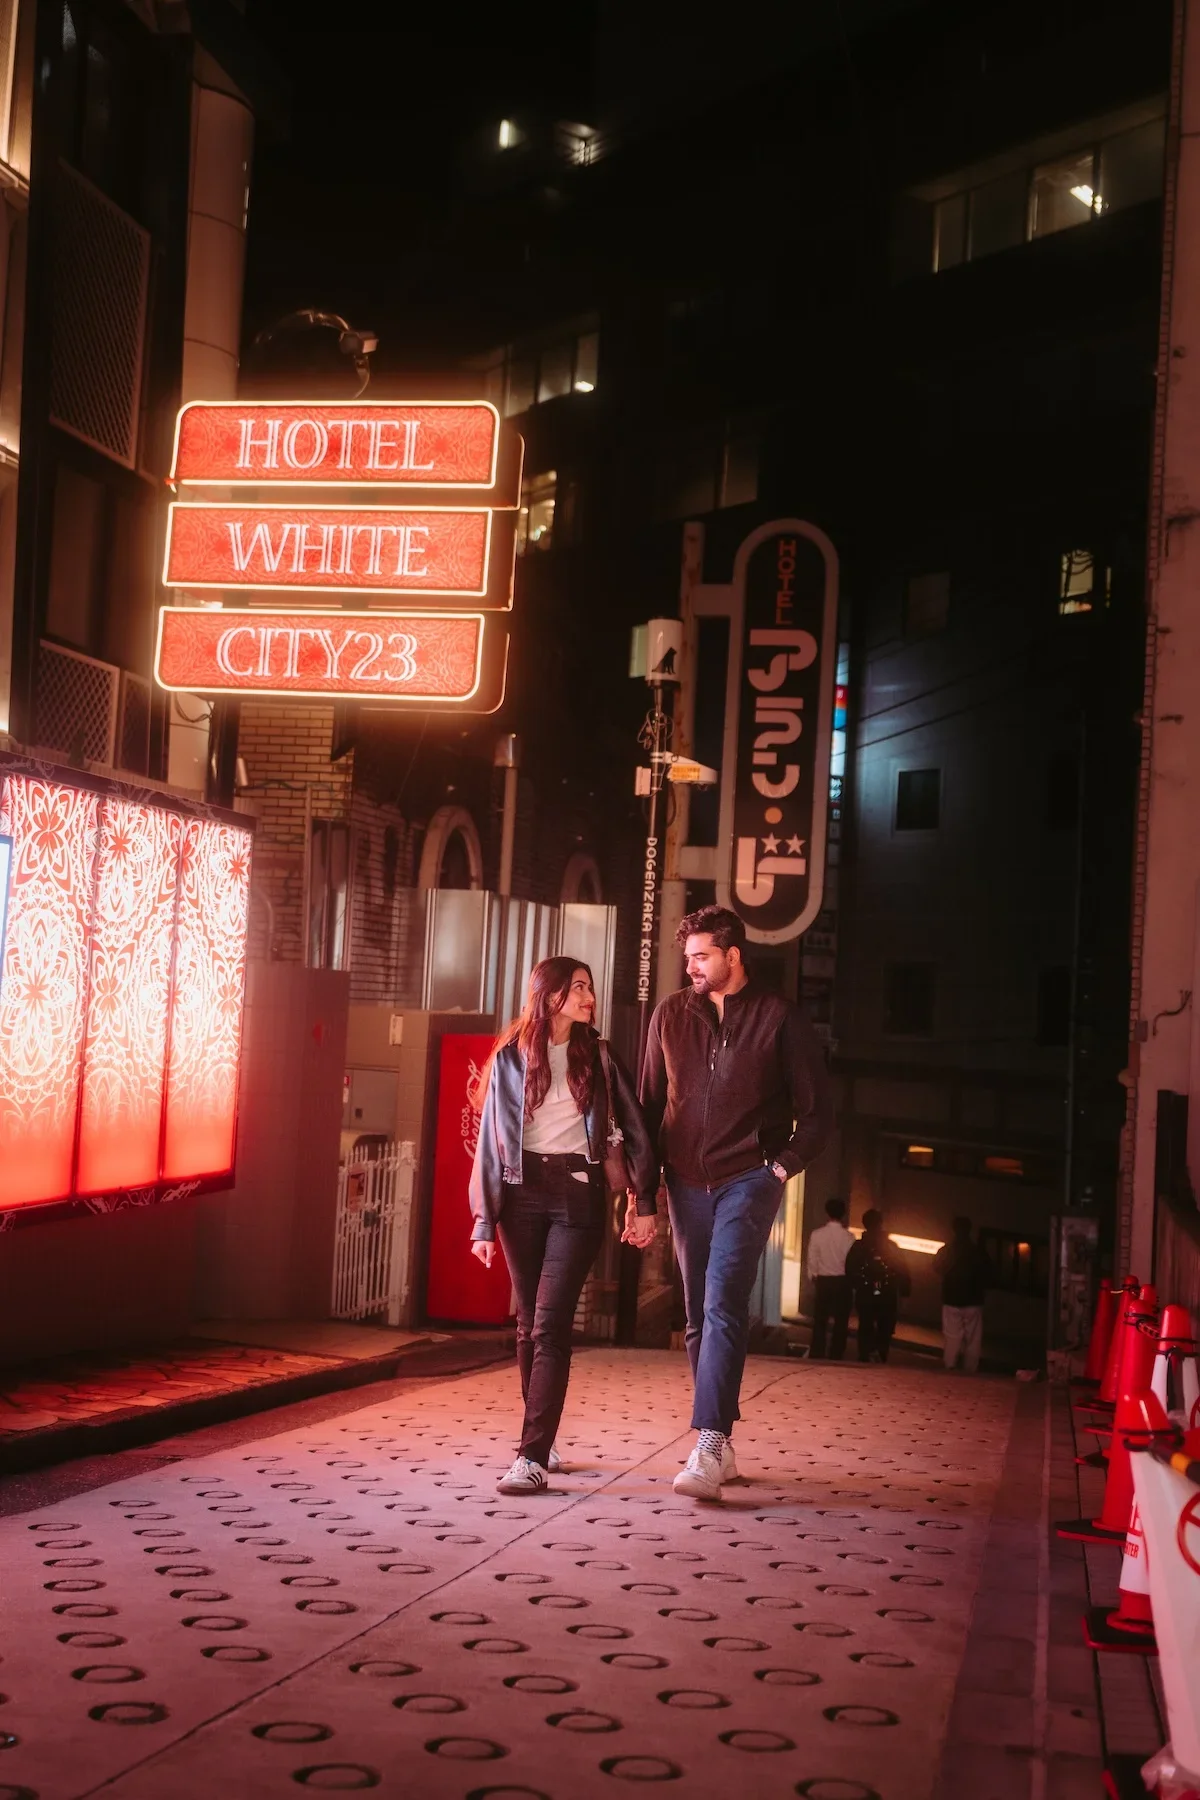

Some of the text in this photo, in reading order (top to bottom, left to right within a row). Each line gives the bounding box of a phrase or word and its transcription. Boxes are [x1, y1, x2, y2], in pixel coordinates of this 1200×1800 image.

[235, 419, 434, 471] HOTEL
[226, 522, 430, 576] WHITE
[775, 540, 797, 625] HOTEL
[216, 626, 418, 682] CITY23
[638, 837, 658, 1001] DOGENZAKA KOMICHI
